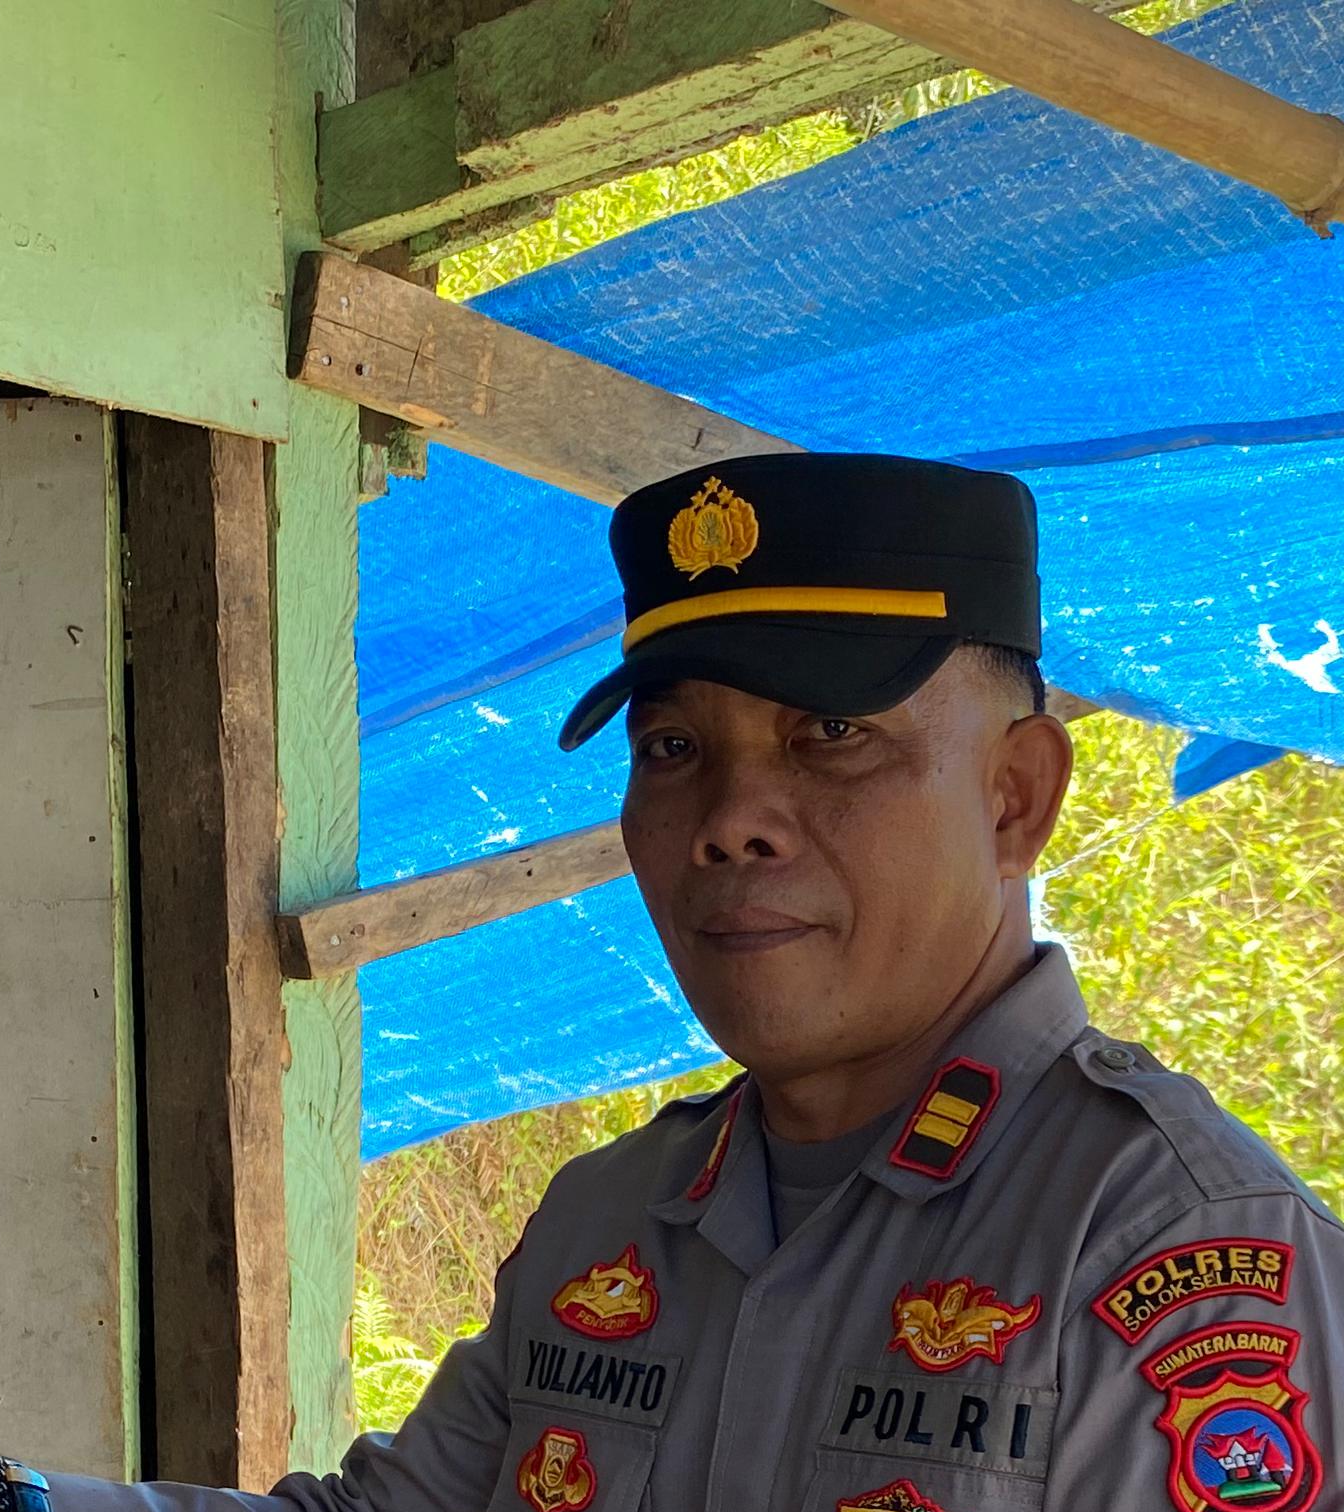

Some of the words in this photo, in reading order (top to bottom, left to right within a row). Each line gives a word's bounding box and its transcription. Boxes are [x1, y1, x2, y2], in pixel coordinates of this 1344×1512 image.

[1108, 1247, 1282, 1321] POLRES
[1124, 1281, 1190, 1332] SOLOK
[524, 1340, 667, 1412] YULIANTO
[839, 1384, 1032, 1459] POLRI
